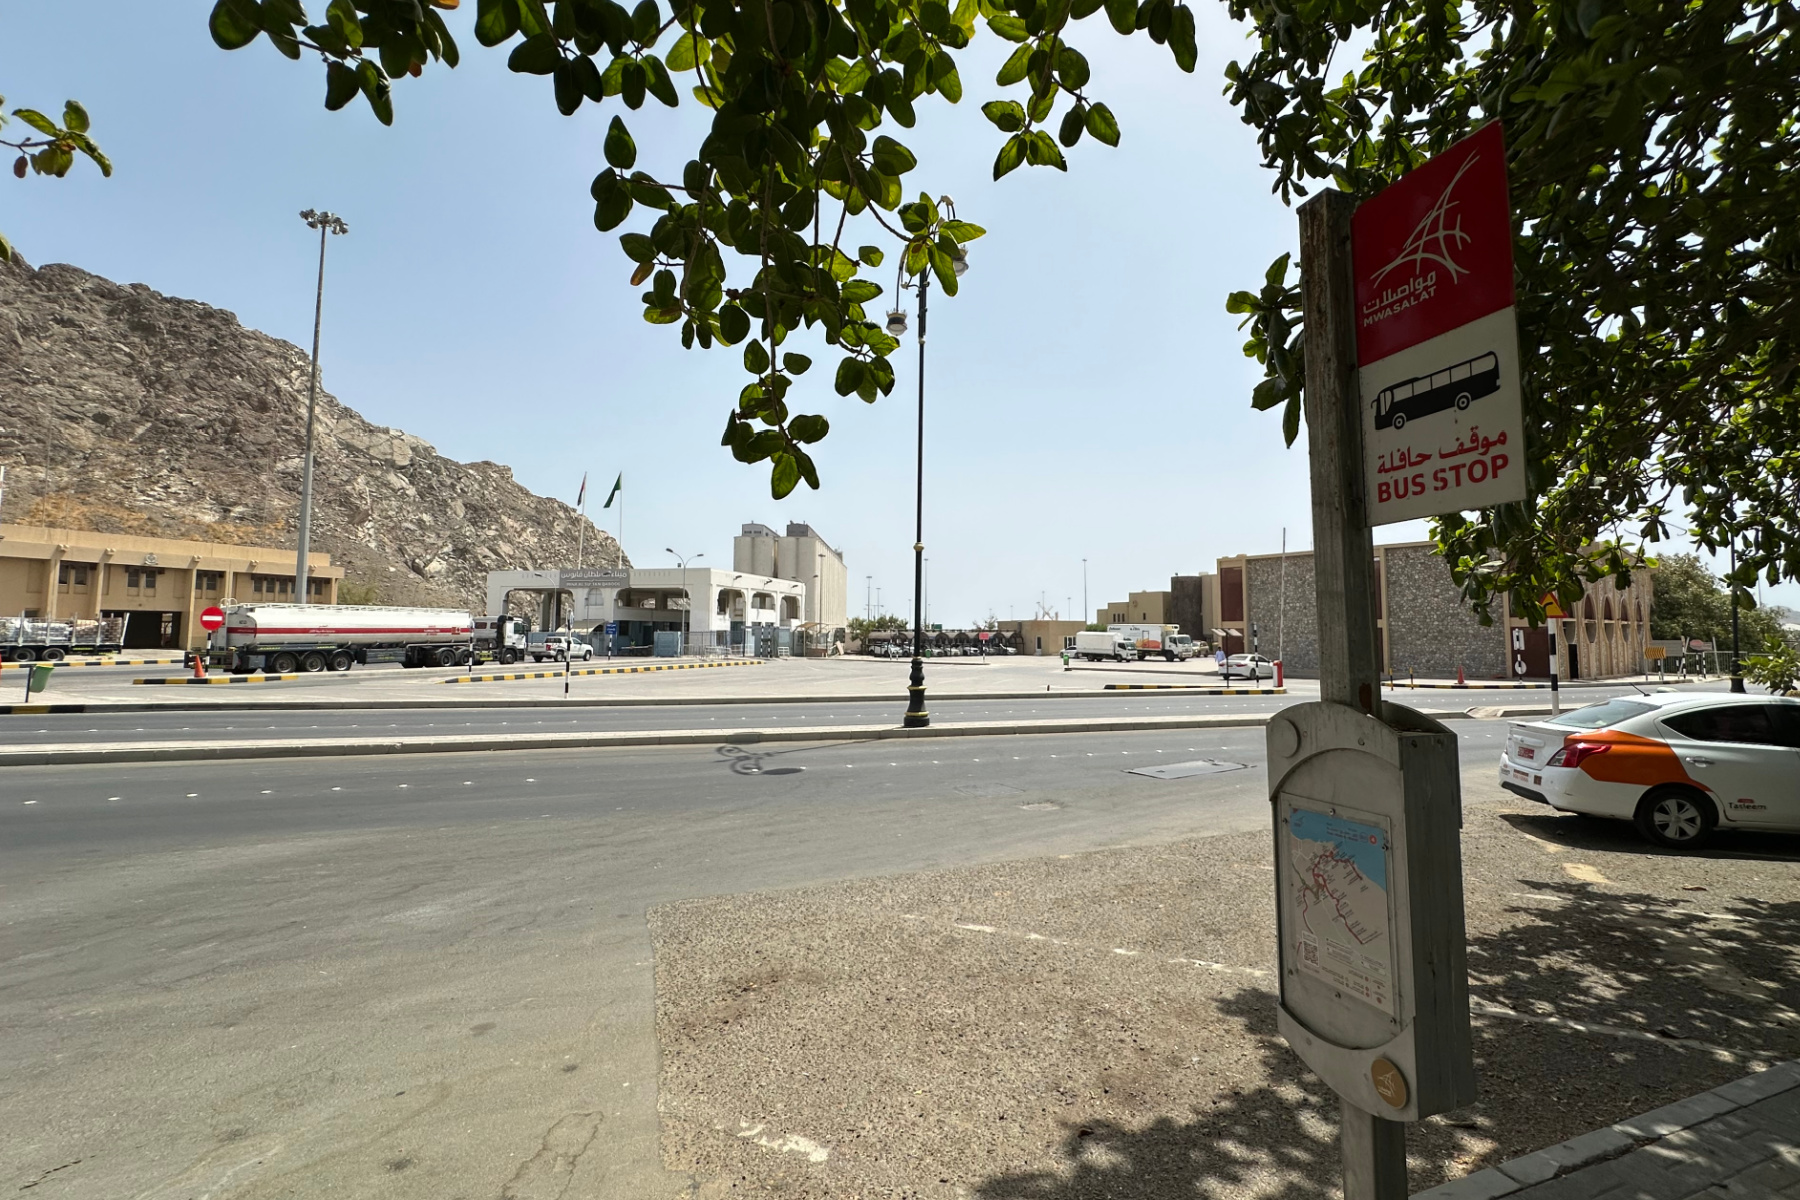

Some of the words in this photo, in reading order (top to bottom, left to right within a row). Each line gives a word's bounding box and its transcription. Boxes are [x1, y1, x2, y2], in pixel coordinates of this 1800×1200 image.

[1363, 271, 1436, 314] مواصلات
[1364, 286, 1437, 327] MWASALAT
[1377, 446, 1433, 474] حافلة
[1438, 426, 1507, 460] موقف
[1378, 473, 1426, 503] BUS
[1433, 454, 1509, 492] STOP
[1728, 802, 1767, 810] Tasleem
